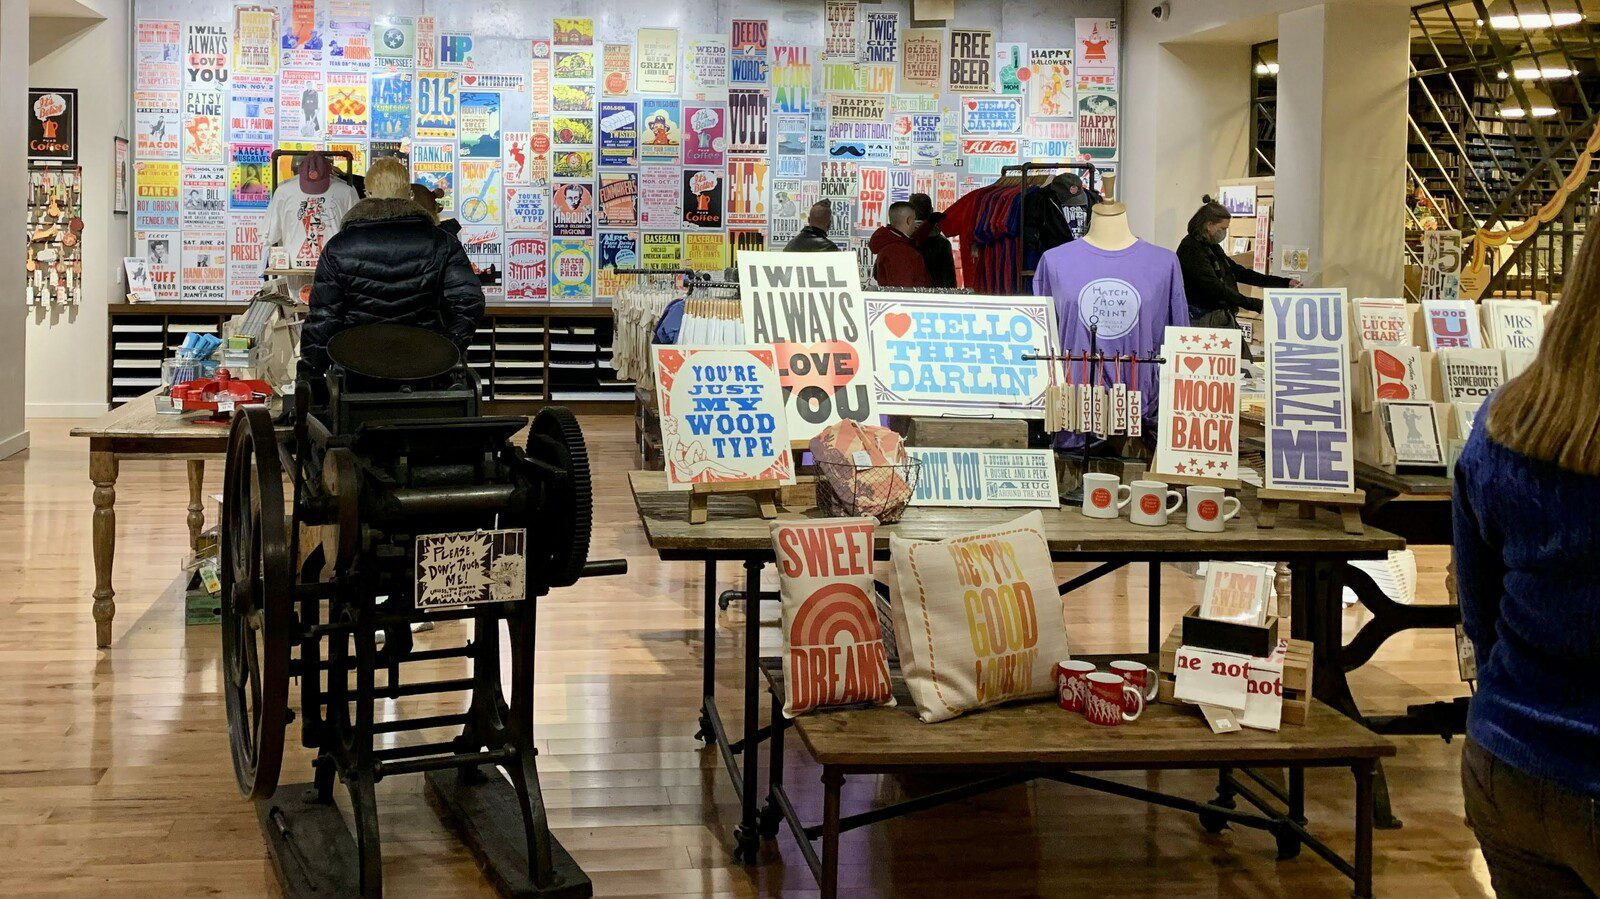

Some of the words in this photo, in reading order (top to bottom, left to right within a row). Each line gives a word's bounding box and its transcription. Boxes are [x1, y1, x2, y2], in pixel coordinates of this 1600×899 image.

[828, 6, 855, 22] LOVE
[189, 26, 193, 34] I
[194, 26, 226, 34] WILL
[732, 22, 767, 48] DEEDS
[830, 22, 852, 38] YOU
[868, 20, 897, 41] TWICE
[188, 35, 228, 54] ALWAYS
[344, 46, 371, 59] ROBBINS
[440, 35, 473, 62] HP
[826, 38, 856, 54] MORE
[950, 32, 990, 59] FREE
[191, 56, 224, 66] LOVE
[774, 46, 808, 66] Y'ALL
[866, 46, 896, 62] ONCE
[1031, 50, 1071, 59] HAPPY
[378, 58, 409, 68] TENNESSEE
[188, 68, 228, 82] YOU
[950, 60, 989, 85] BEER
[188, 92, 221, 104] PATSY
[418, 78, 454, 116] 615
[773, 86, 810, 113] ALL
[187, 104, 221, 116] CLINE
[832, 106, 884, 118] BIRTHDAY
[978, 101, 1016, 110] HELLO
[729, 93, 768, 144] VOTE
[914, 116, 940, 126] KEEP
[968, 112, 1016, 120] THERE
[1080, 115, 1115, 128] HAPPY
[830, 122, 852, 139] HAPPY
[855, 123, 892, 140] BIRTHDAY!
[1080, 129, 1116, 148] HOLIDAYS
[238, 147, 265, 156] KACEY
[414, 146, 452, 162] FRANKLIN
[860, 169, 886, 190] YOU
[890, 171, 910, 187] YOU
[142, 186, 176, 196] DANCE
[207, 189, 219, 200] BILL
[821, 183, 849, 196] PICKIN'
[860, 191, 885, 201] DID
[137, 201, 148, 211] ROY
[152, 201, 179, 212] ORBISON
[202, 200, 226, 211] MONROE
[166, 217, 179, 226] MEN
[554, 211, 592, 224] MARQUIS
[686, 211, 720, 222] Coffee
[236, 227, 258, 243] ELVIS
[645, 235, 679, 244] BASEBALL
[688, 235, 722, 244] BASEBALL
[231, 244, 263, 260] PRESLEY
[463, 243, 481, 254] SHOW
[483, 243, 502, 254] PRINT
[509, 242, 546, 258] ROGERS
[749, 265, 758, 287] I
[762, 266, 847, 287] WILL
[752, 291, 859, 344] ALWAYS
[1270, 297, 1343, 342] YOU
[1362, 320, 1405, 330] LUCKY
[1504, 315, 1532, 328] MRS
[911, 312, 1032, 342] HELLO
[1432, 318, 1468, 336] U
[1364, 331, 1402, 341] CHAR
[1436, 338, 1469, 347] BE
[1506, 335, 1534, 348] MRS
[886, 340, 1036, 366] THERE
[692, 365, 758, 382] YOU'RE
[1175, 355, 1180, 373] I
[1209, 356, 1236, 376] YOU
[1452, 365, 1498, 376] EVERYBODY'S
[889, 363, 1038, 396] DARLIN'
[1275, 342, 1342, 428] AMAZE
[1453, 376, 1499, 387] SOMEBODY'S
[688, 384, 763, 395] JUST
[1173, 379, 1235, 414] MOON
[692, 397, 763, 412] MY
[1116, 388, 1125, 427] LOVE
[1130, 396, 1139, 435] LOVE
[686, 414, 776, 436] WOOD
[1172, 417, 1233, 452] BACK
[712, 436, 774, 458] TYPE
[983, 456, 988, 465] A
[989, 456, 1010, 465] BUSHEL
[1012, 456, 1024, 465] AND
[1025, 456, 1030, 465] A
[1272, 429, 1348, 482] ME
[913, 452, 950, 500] LOVE
[952, 452, 982, 501] YOU
[984, 469, 988, 478] A
[990, 469, 1012, 478] BUSHEL
[1014, 469, 1026, 478] AND
[1027, 469, 1032, 478] A
[778, 525, 875, 578] SWEET
[1215, 571, 1258, 592] I'M
[963, 581, 1038, 657] GOOD
[790, 641, 892, 710] DREAMS
[1211, 662, 1251, 680] not
[1247, 678, 1282, 696] not
